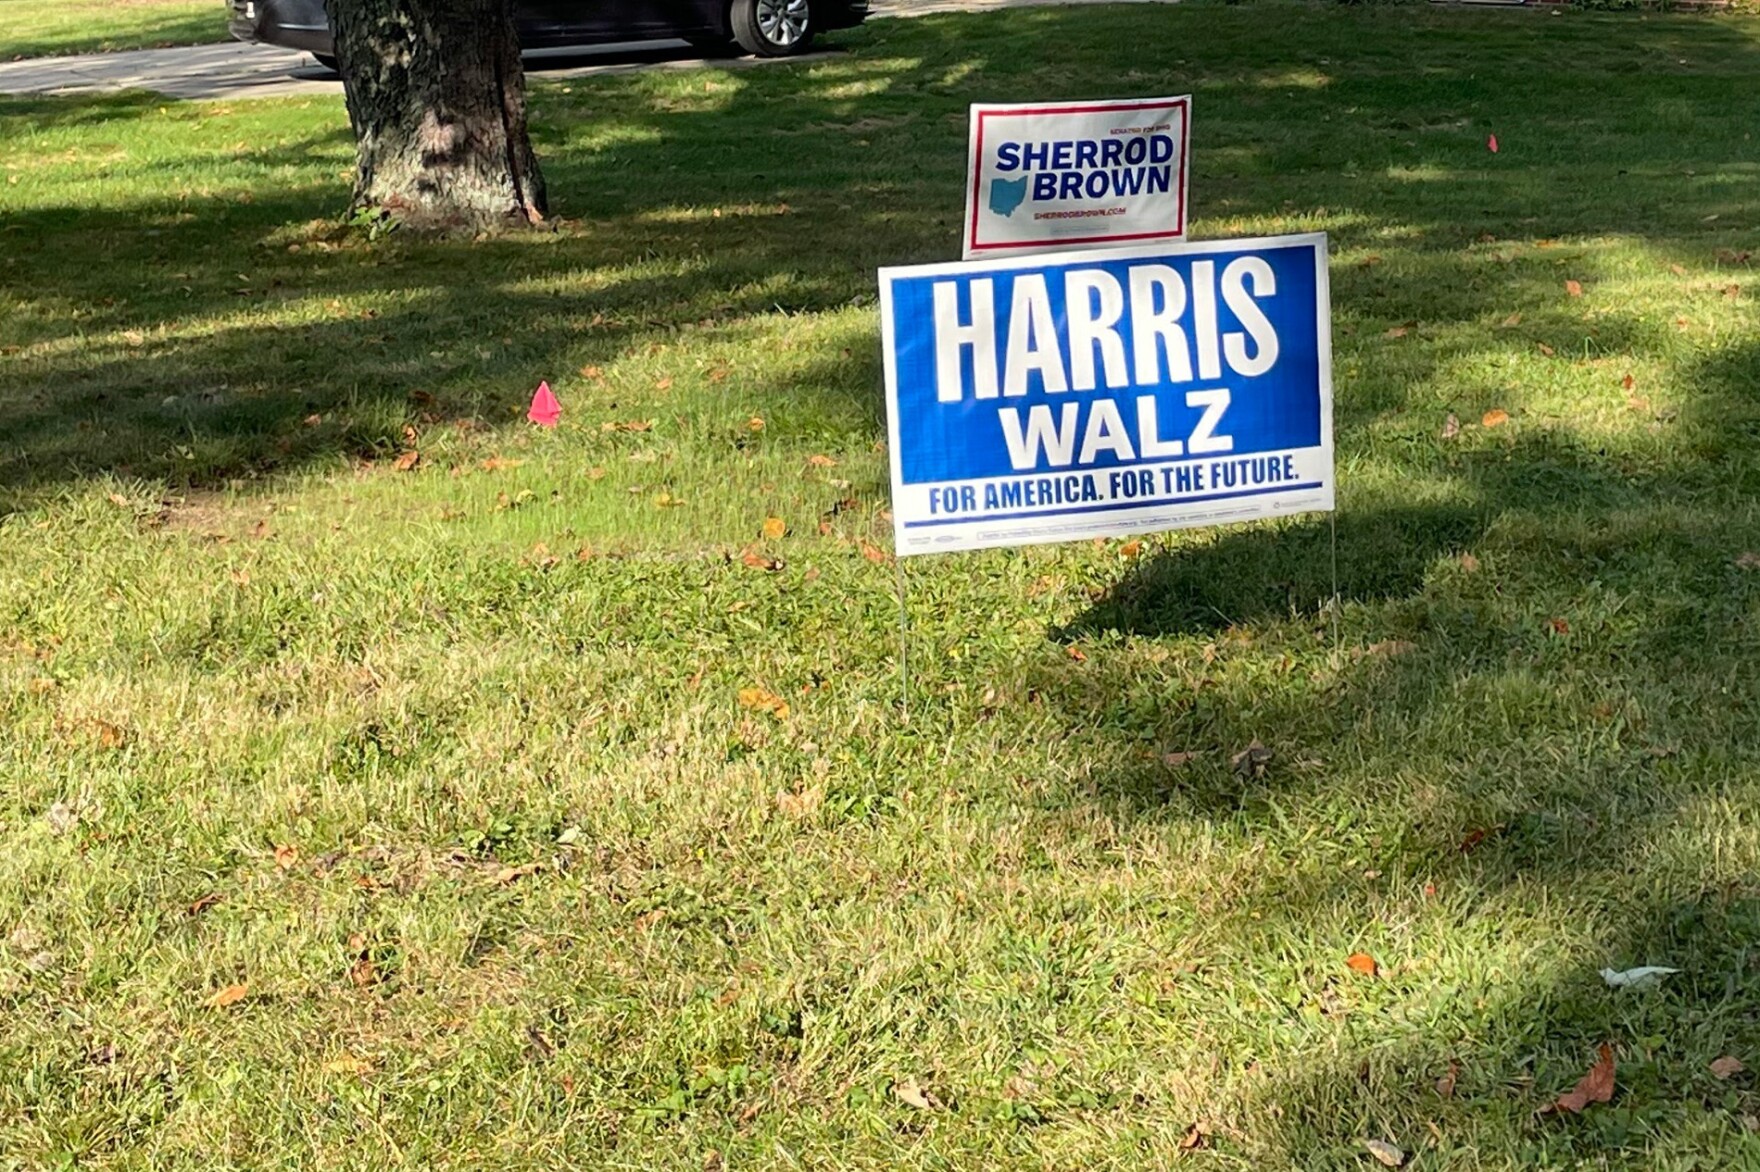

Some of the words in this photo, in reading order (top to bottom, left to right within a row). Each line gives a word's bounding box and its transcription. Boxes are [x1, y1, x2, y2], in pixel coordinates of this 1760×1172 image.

[995, 134, 1174, 172] SHERROD
[1032, 165, 1171, 201] BROWN
[932, 256, 1280, 402] HARRIS
[998, 388, 1234, 470] WALZ
[929, 486, 977, 514] FOR
[984, 474, 1104, 510] AMERICA.
[1110, 469, 1155, 499] FOR
[1160, 465, 1202, 492] THE
[1210, 454, 1299, 487] FUTURE.
